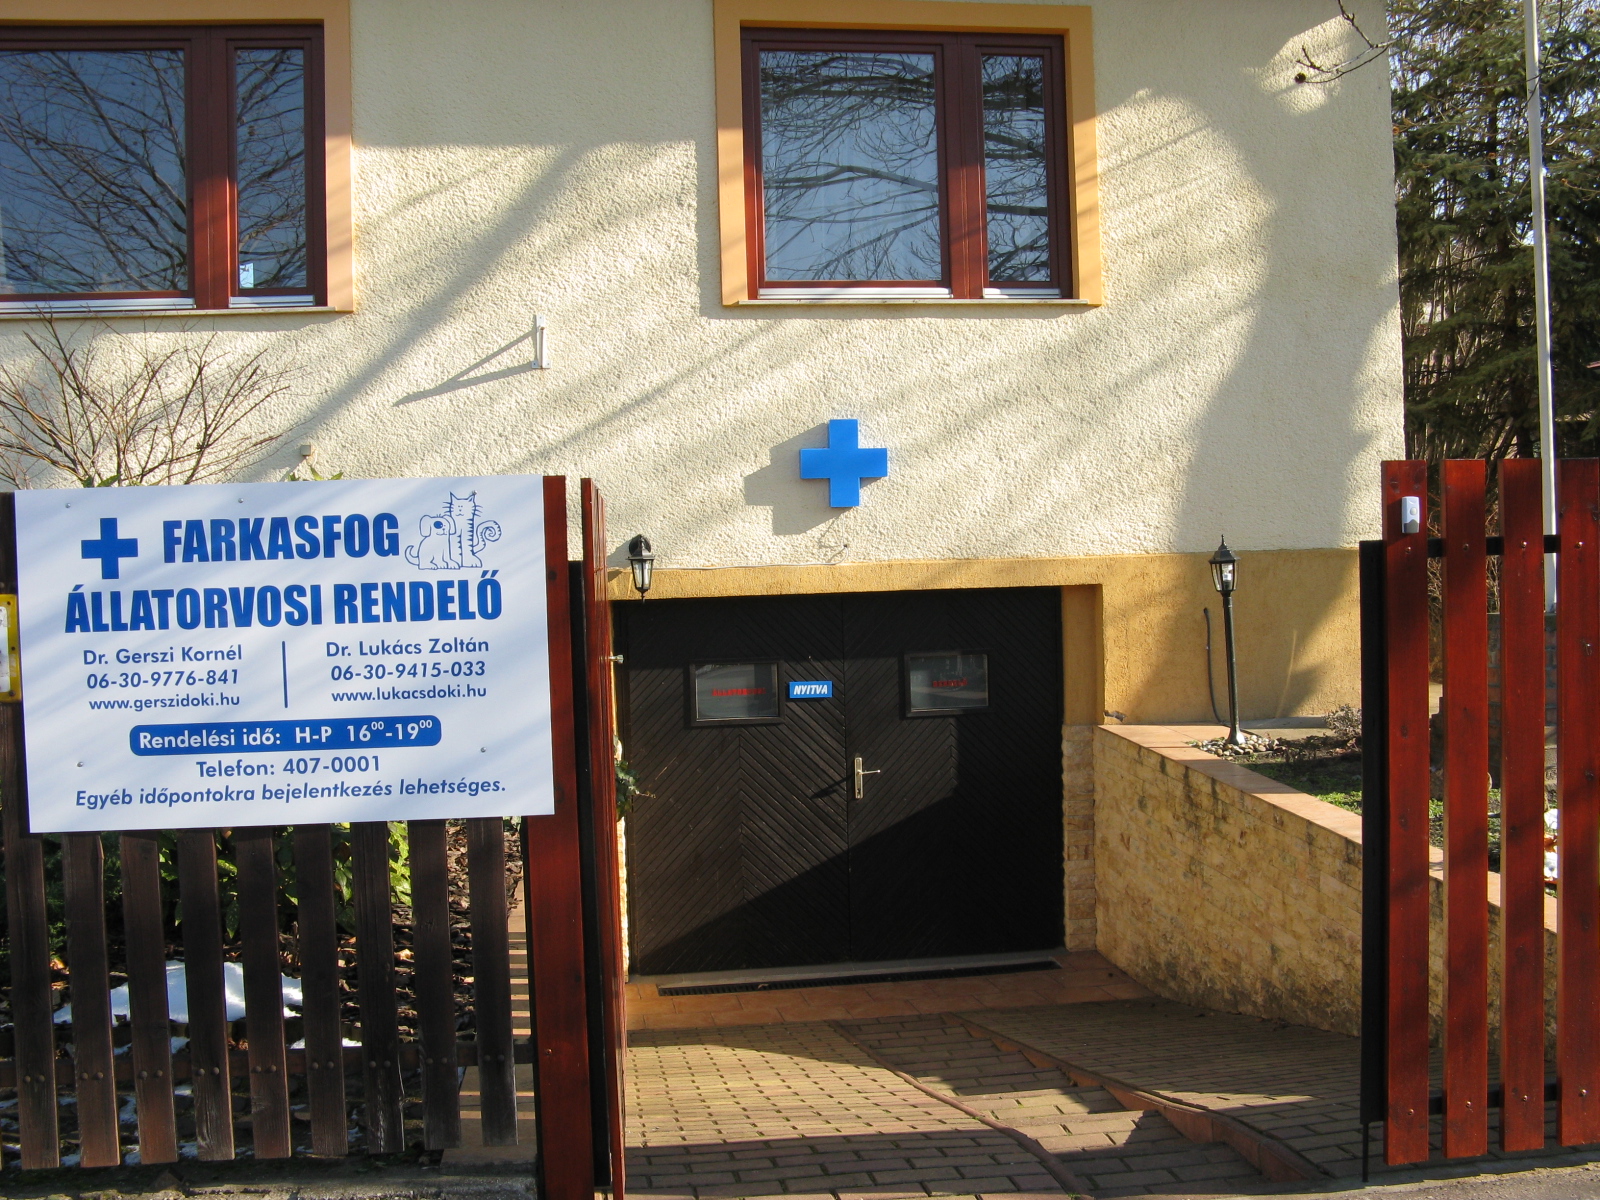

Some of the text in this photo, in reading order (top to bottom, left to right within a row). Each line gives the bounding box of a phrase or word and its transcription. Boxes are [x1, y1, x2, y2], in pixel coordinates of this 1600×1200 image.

[163, 513, 399, 563] FARKASFOG
[65, 569, 501, 633] ÁLLATORVOSI RENDELŐ
[83, 644, 242, 665] Dr. Gerszi Kornél
[326, 637, 489, 657] Dr. Lukács Zoltán
[87, 670, 238, 688] 06-30-9776-841
[331, 661, 486, 680] 06-30-9415-033
[331, 684, 487, 702] www.lukacsdoki.hu
[793, 684, 828, 696] NYITVA
[89, 693, 240, 711] www.gerszidoki.hu
[139, 728, 235, 749] Rendelési
[242, 727, 281, 745] idő:
[295, 726, 332, 744] H-P
[196, 755, 379, 777] Telefon: 407-0001
[76, 777, 506, 810] Egyéb időpontokra bejelentkezés lehetséges.
